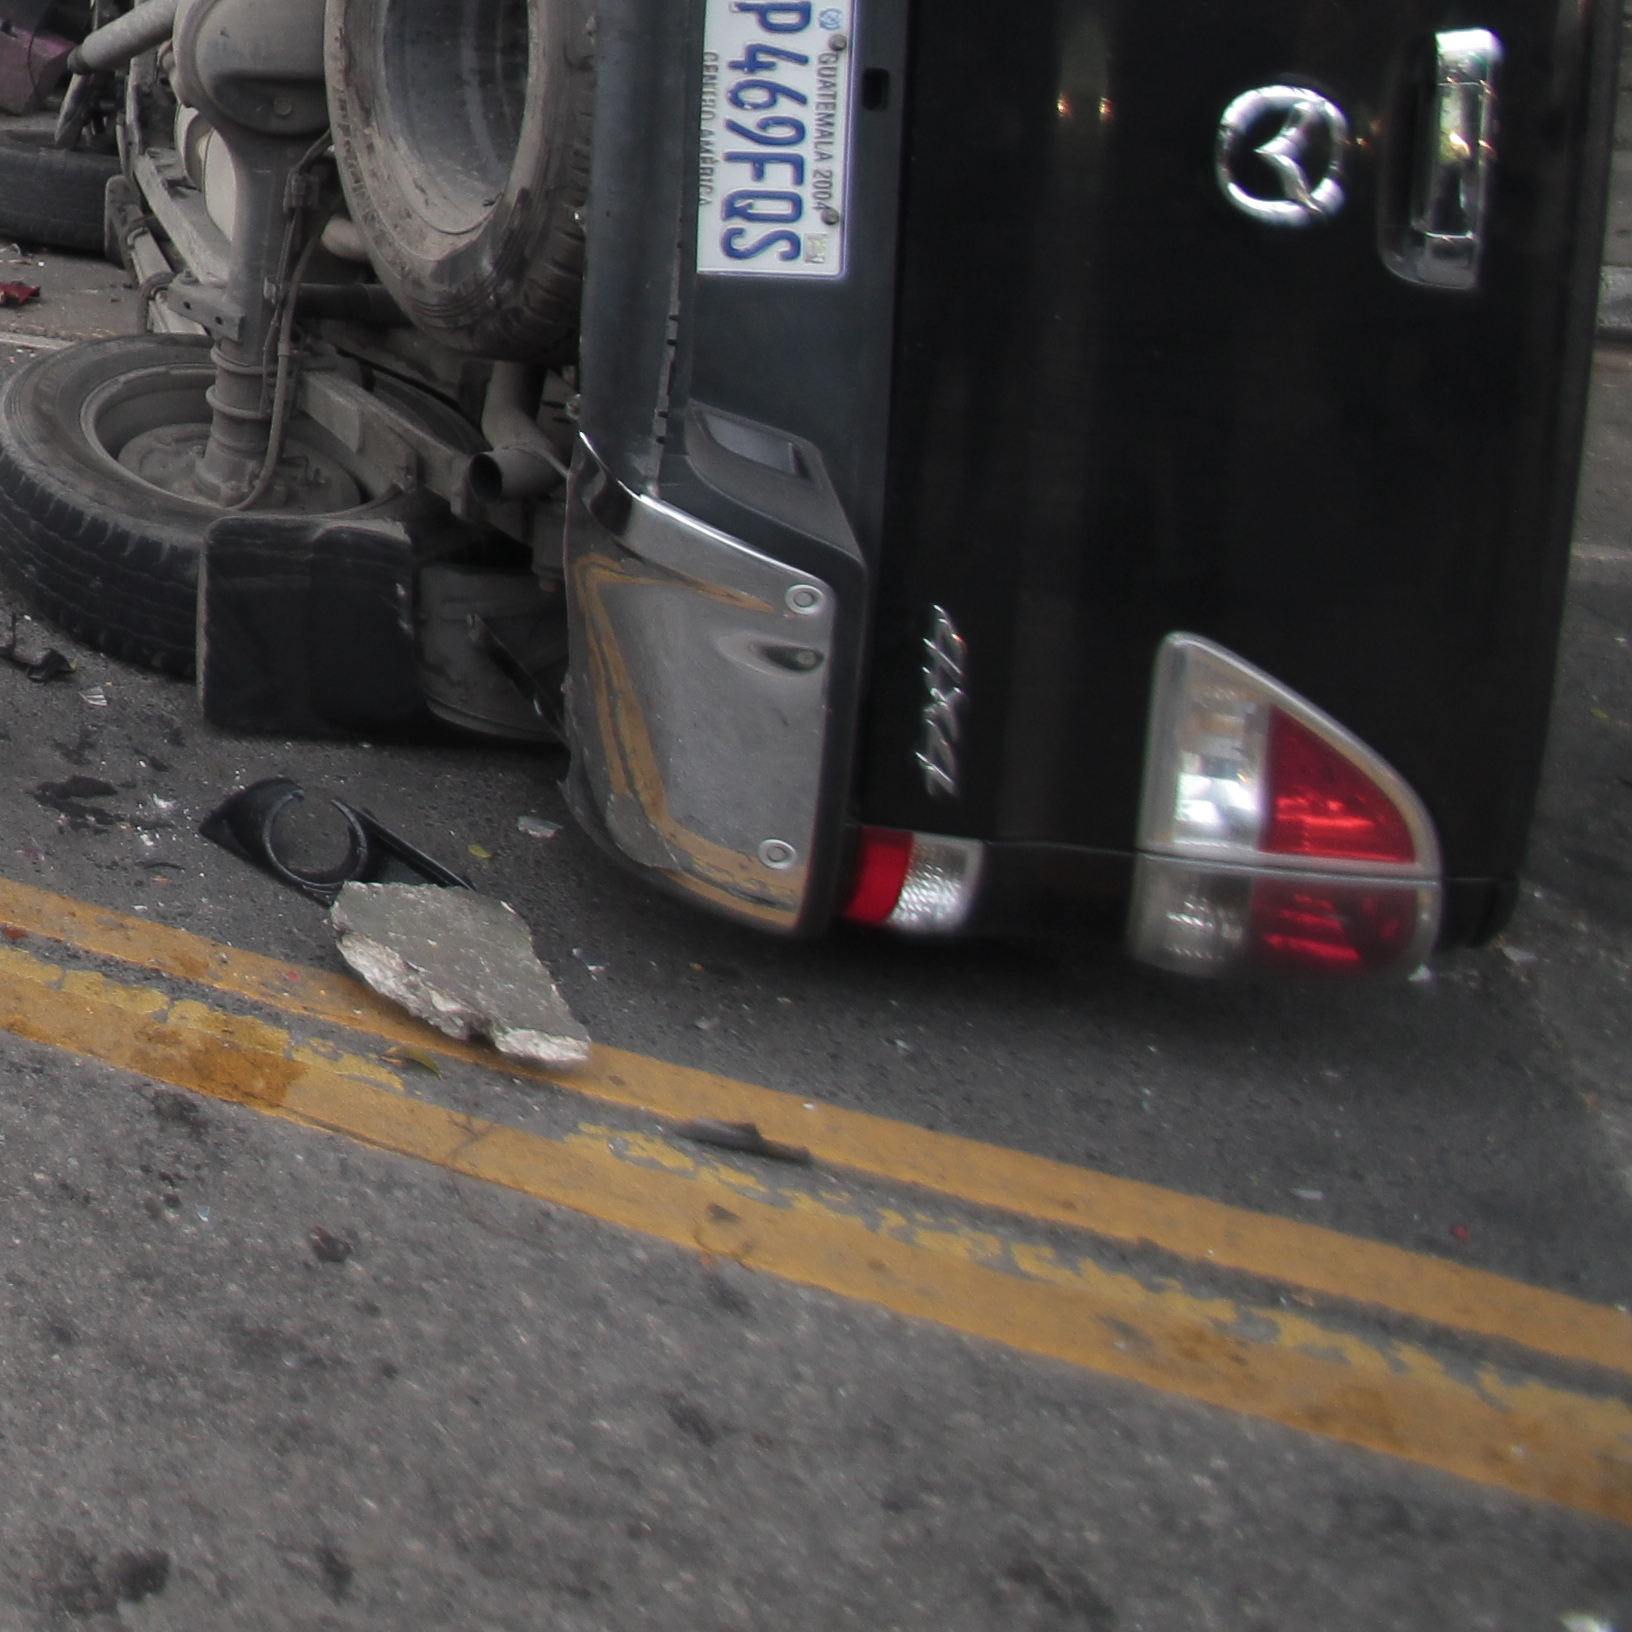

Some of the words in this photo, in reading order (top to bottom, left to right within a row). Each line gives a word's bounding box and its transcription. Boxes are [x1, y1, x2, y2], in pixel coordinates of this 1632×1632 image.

[701, 51, 719, 121] CENTRO
[720, 0, 813, 261] P469FQS
[813, 52, 838, 163] GUATEMALA
[811, 169, 833, 211] 2004
